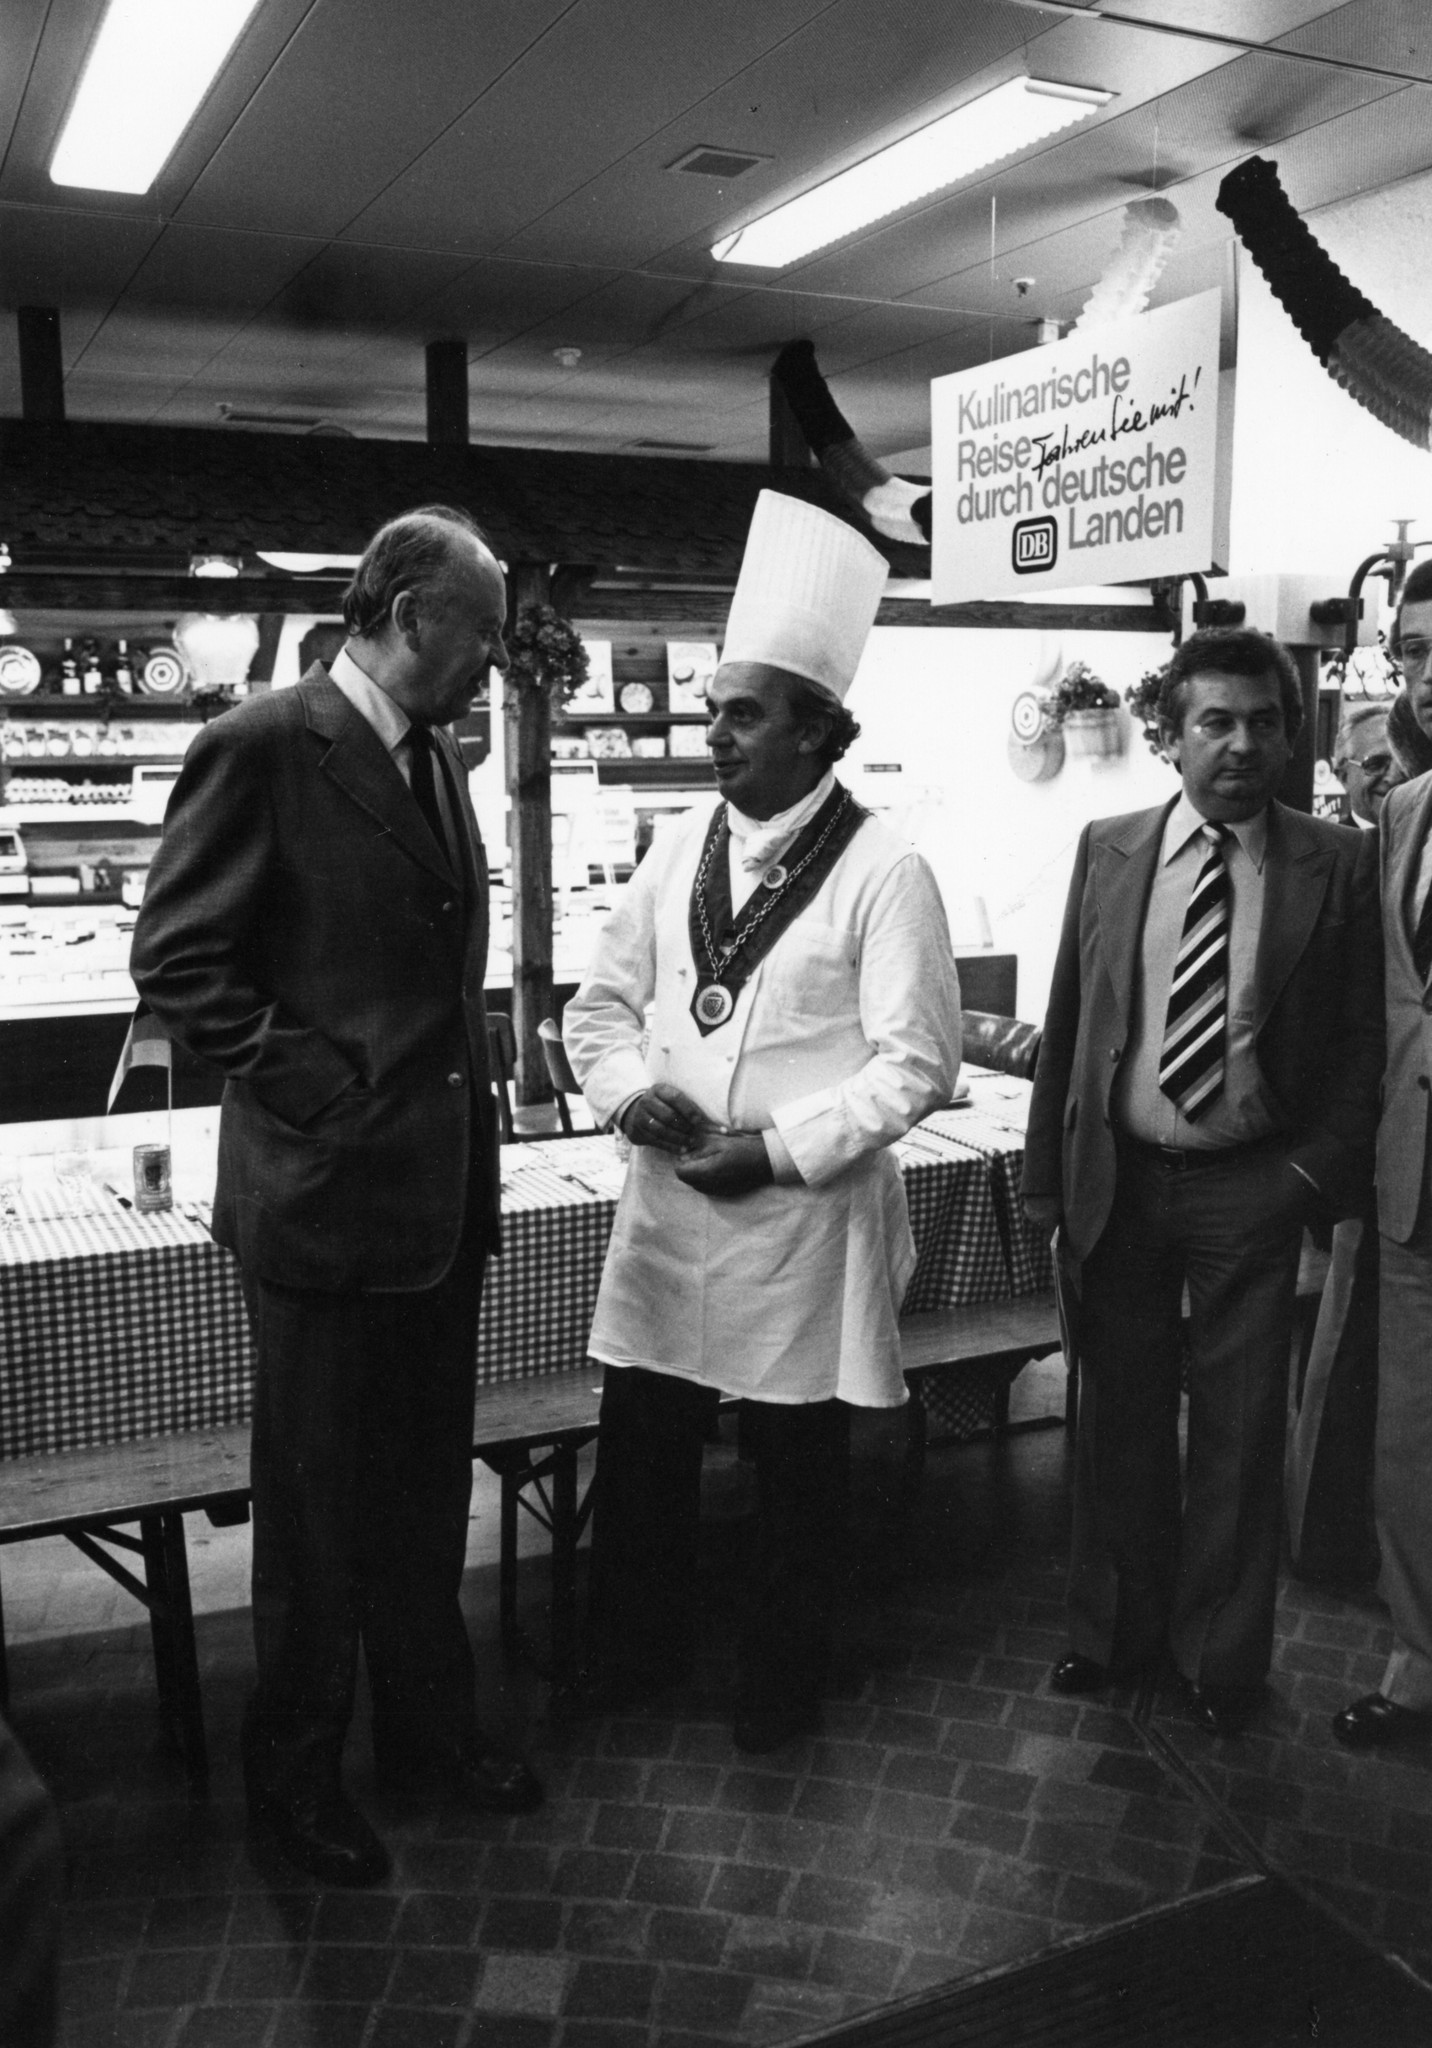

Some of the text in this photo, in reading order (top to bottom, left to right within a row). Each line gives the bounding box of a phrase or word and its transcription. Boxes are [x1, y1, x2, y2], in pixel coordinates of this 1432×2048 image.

[958, 354, 1131, 434] Kulinarische
[957, 433, 1032, 482] Reise
[1031, 424, 1107, 482] Fahren
[1110, 394, 1148, 441] Sie
[957, 441, 1187, 524] durch deutsche
[1019, 530, 1050, 561] DB
[1068, 494, 1184, 550] Landen
